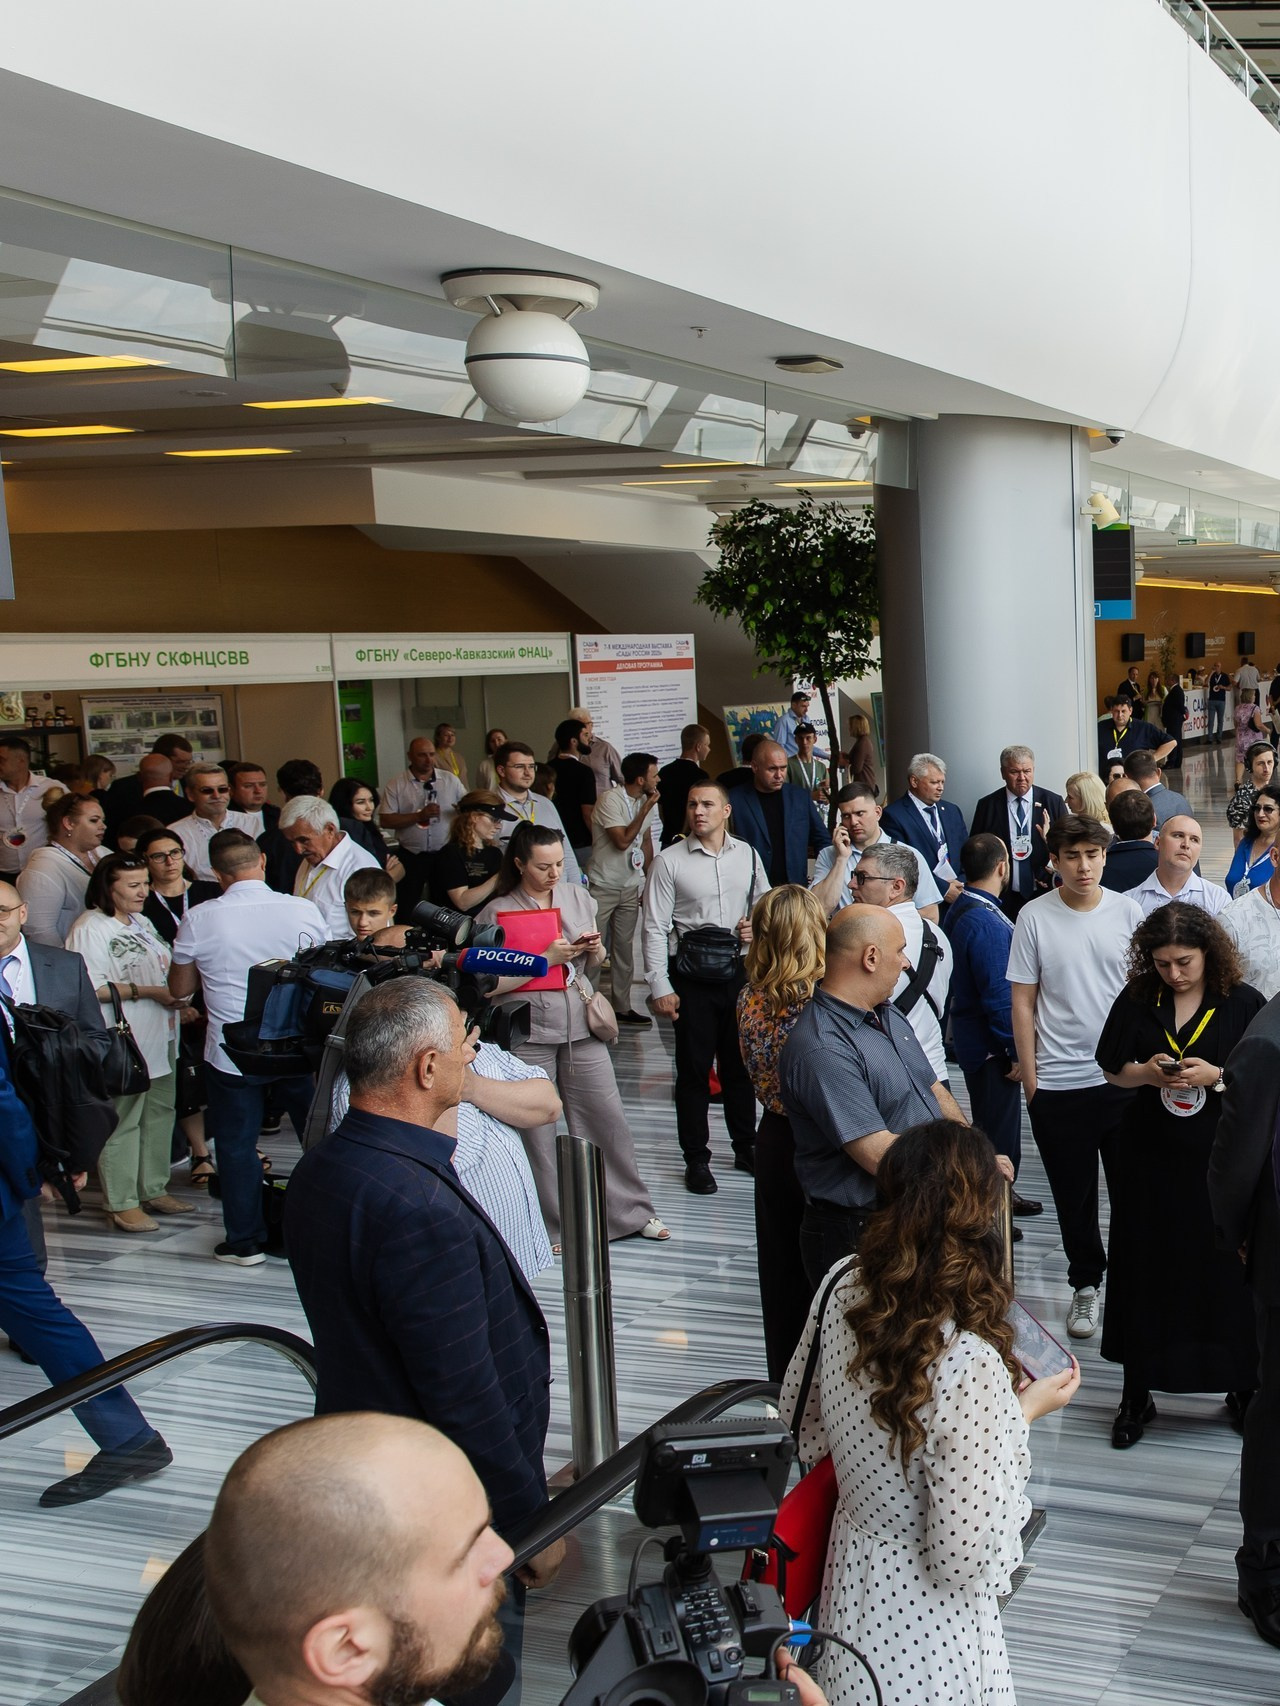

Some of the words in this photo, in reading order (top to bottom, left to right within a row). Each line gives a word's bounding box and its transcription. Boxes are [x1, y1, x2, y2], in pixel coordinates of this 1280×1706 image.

[89, 652, 150, 668] ФГБНУ
[156, 651, 249, 668] СКФНЦСВВ
[355, 649, 399, 662] ФГБНУ
[403, 647, 515, 663] «Северо-Кавказский
[518, 646, 553, 659] ФНАЦ»
[477, 950, 535, 966] РОССИЯ
